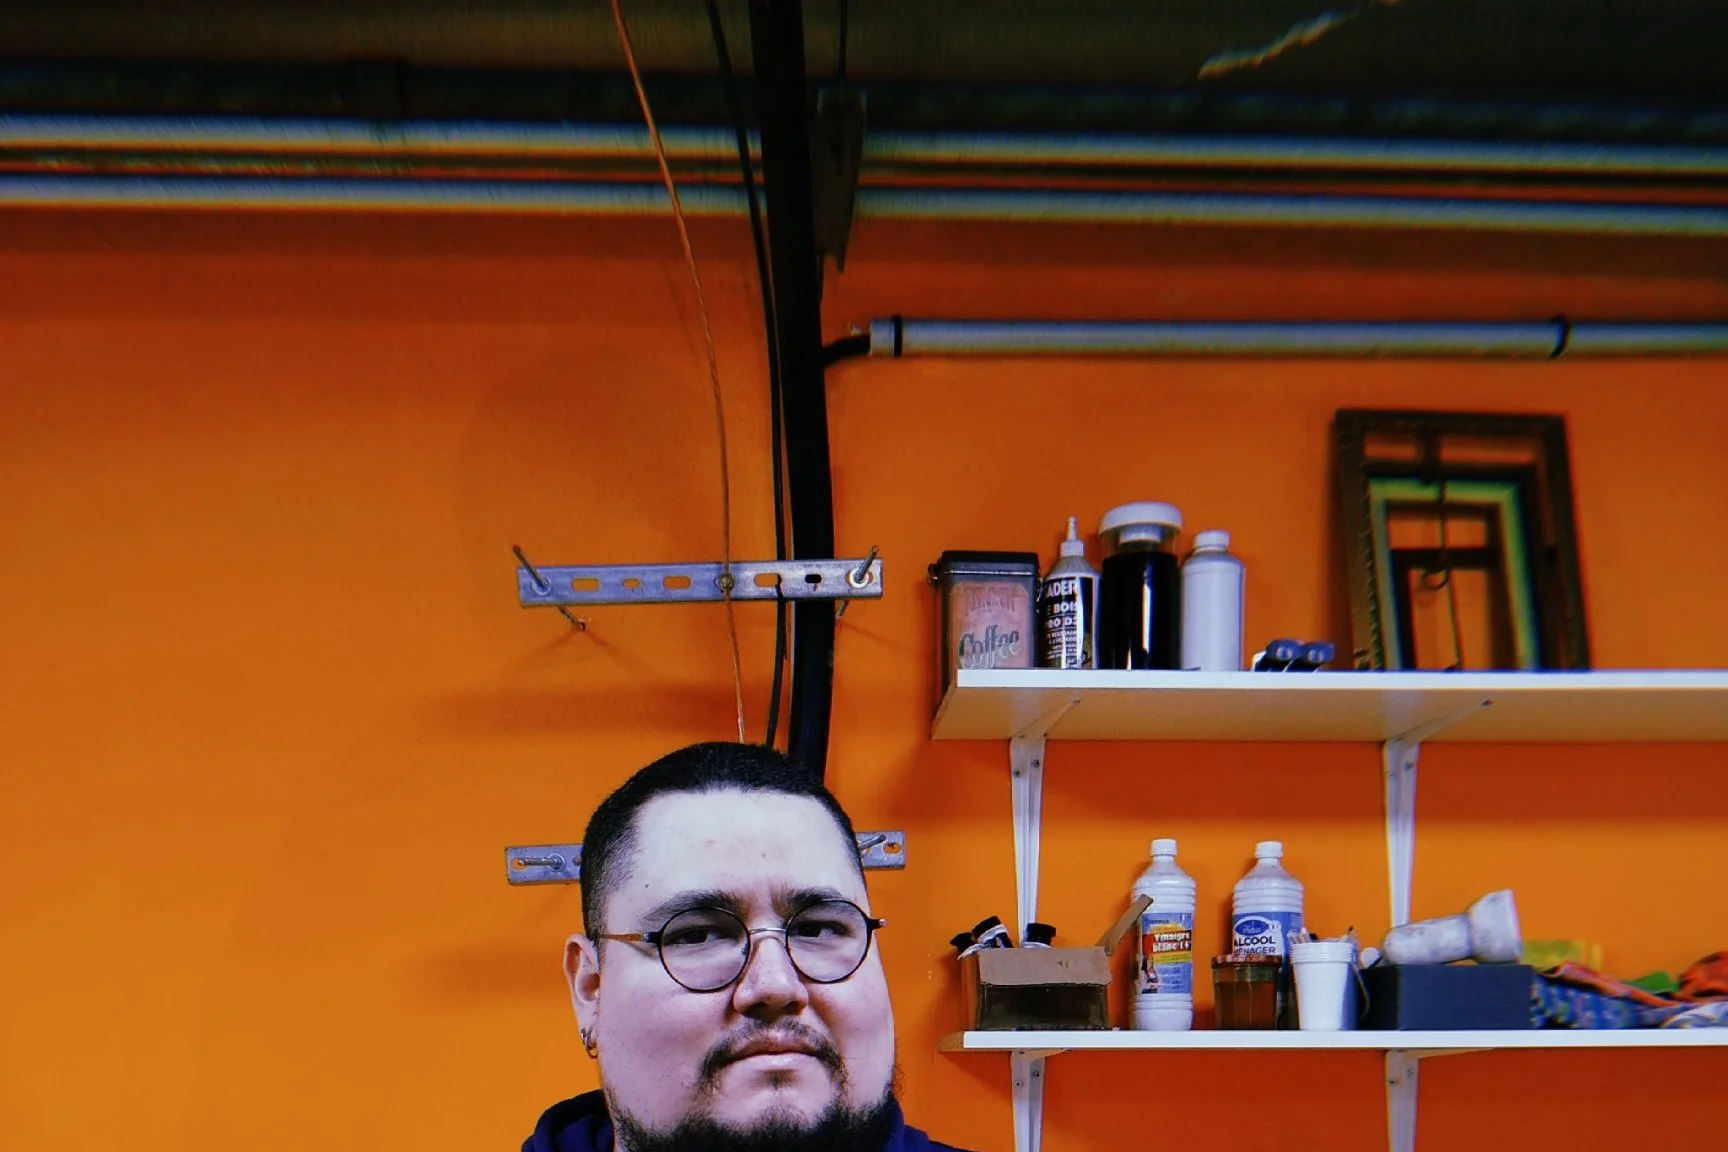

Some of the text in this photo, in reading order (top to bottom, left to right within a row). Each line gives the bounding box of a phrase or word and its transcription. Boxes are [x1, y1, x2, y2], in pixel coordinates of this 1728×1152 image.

[1045, 579, 1078, 598] ADER
[958, 624, 1020, 668] Coffee
[1234, 936, 1276, 946] ALCOOL
